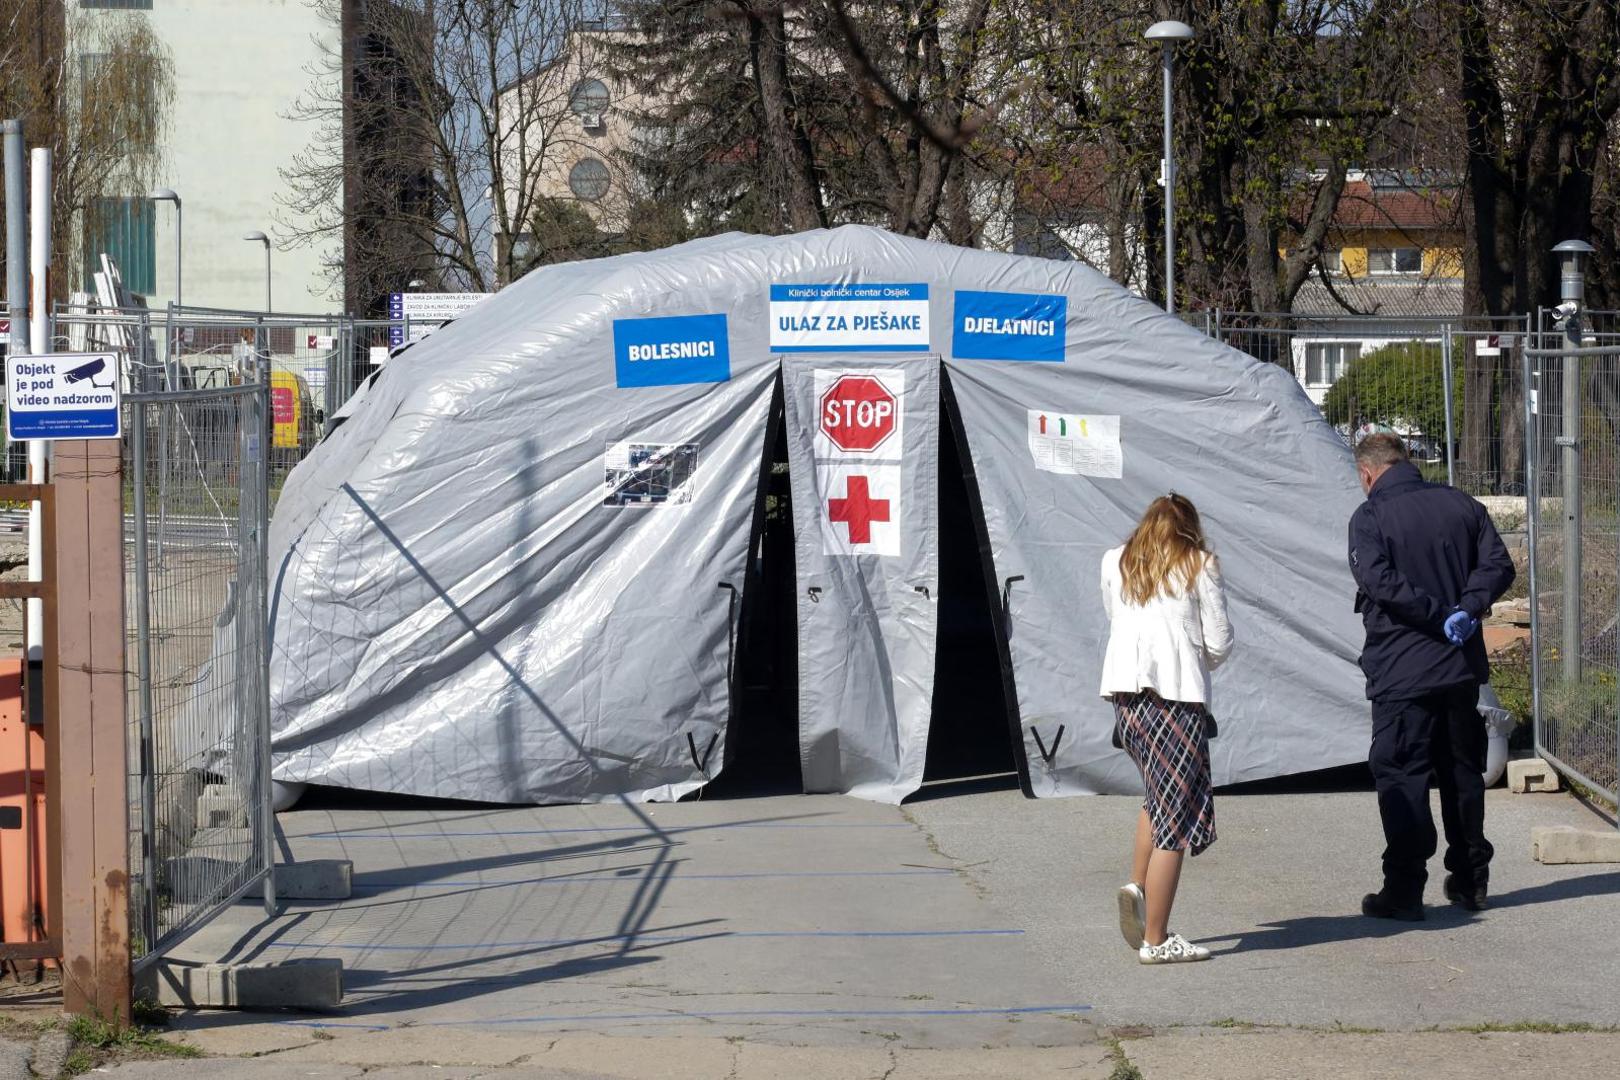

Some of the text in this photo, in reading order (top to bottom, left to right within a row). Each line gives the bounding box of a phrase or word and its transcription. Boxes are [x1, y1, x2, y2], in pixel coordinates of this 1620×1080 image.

[788, 288, 910, 298] Klinički bolnički centar Osijek
[779, 311, 921, 331] ULAZ ZA PJEŠAKE
[964, 316, 1055, 336] DJELATNICI
[628, 340, 715, 361] BOLESNICI
[16, 364, 55, 376] Objekt
[16, 379, 54, 392] je pod
[17, 394, 113, 405] video nadzorom
[824, 399, 892, 428] STOP
